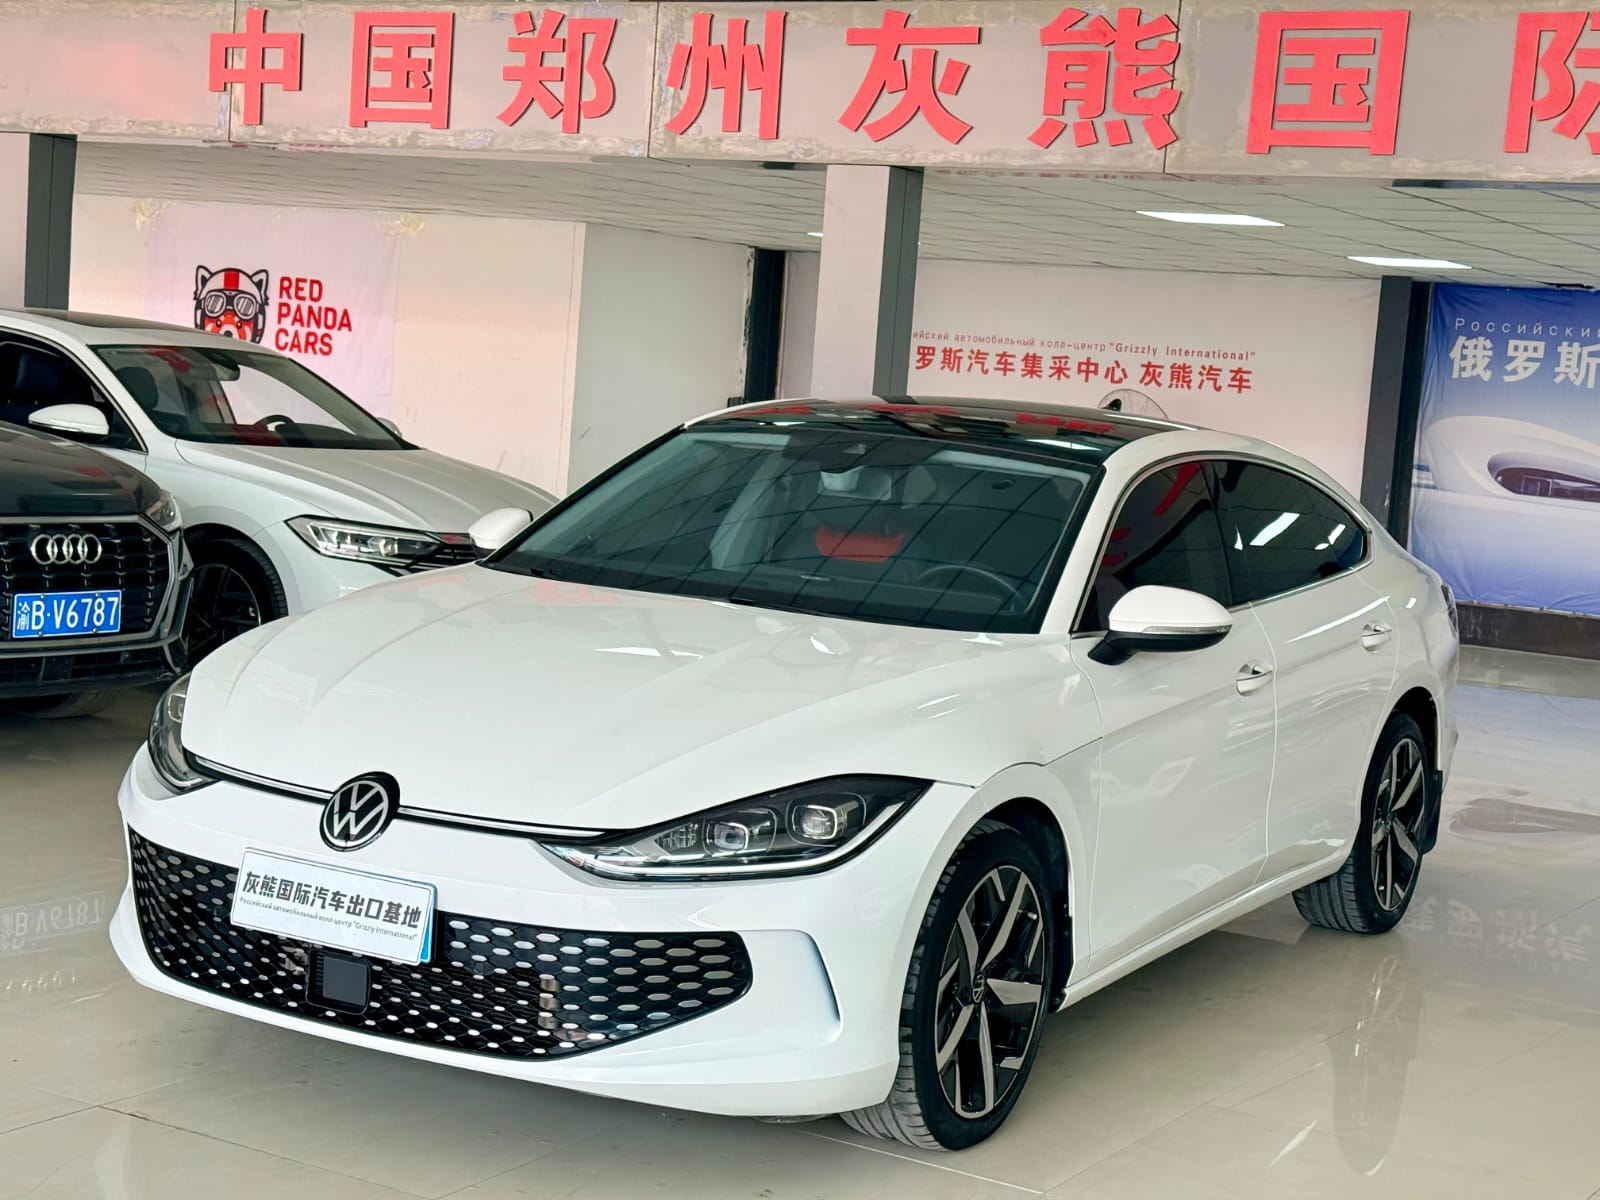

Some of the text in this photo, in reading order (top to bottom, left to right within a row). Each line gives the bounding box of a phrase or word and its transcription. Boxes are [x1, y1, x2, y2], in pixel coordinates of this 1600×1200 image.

[279, 276, 323, 302] RED
[277, 302, 352, 332] PANDA
[1455, 318, 1600, 338] Российски
[275, 328, 333, 356] CARS
[954, 333, 1035, 346] автомобильный
[1109, 342, 1158, 356] "Grizzly
[1166, 346, 1256, 361] International"
[915, 345, 1253, 394] 罗斯汽车集采中心 灰熊汽车
[1449, 335, 1600, 389] 俄罗斯
[242, 871, 422, 929] 灰熊国际汽车出口基地
